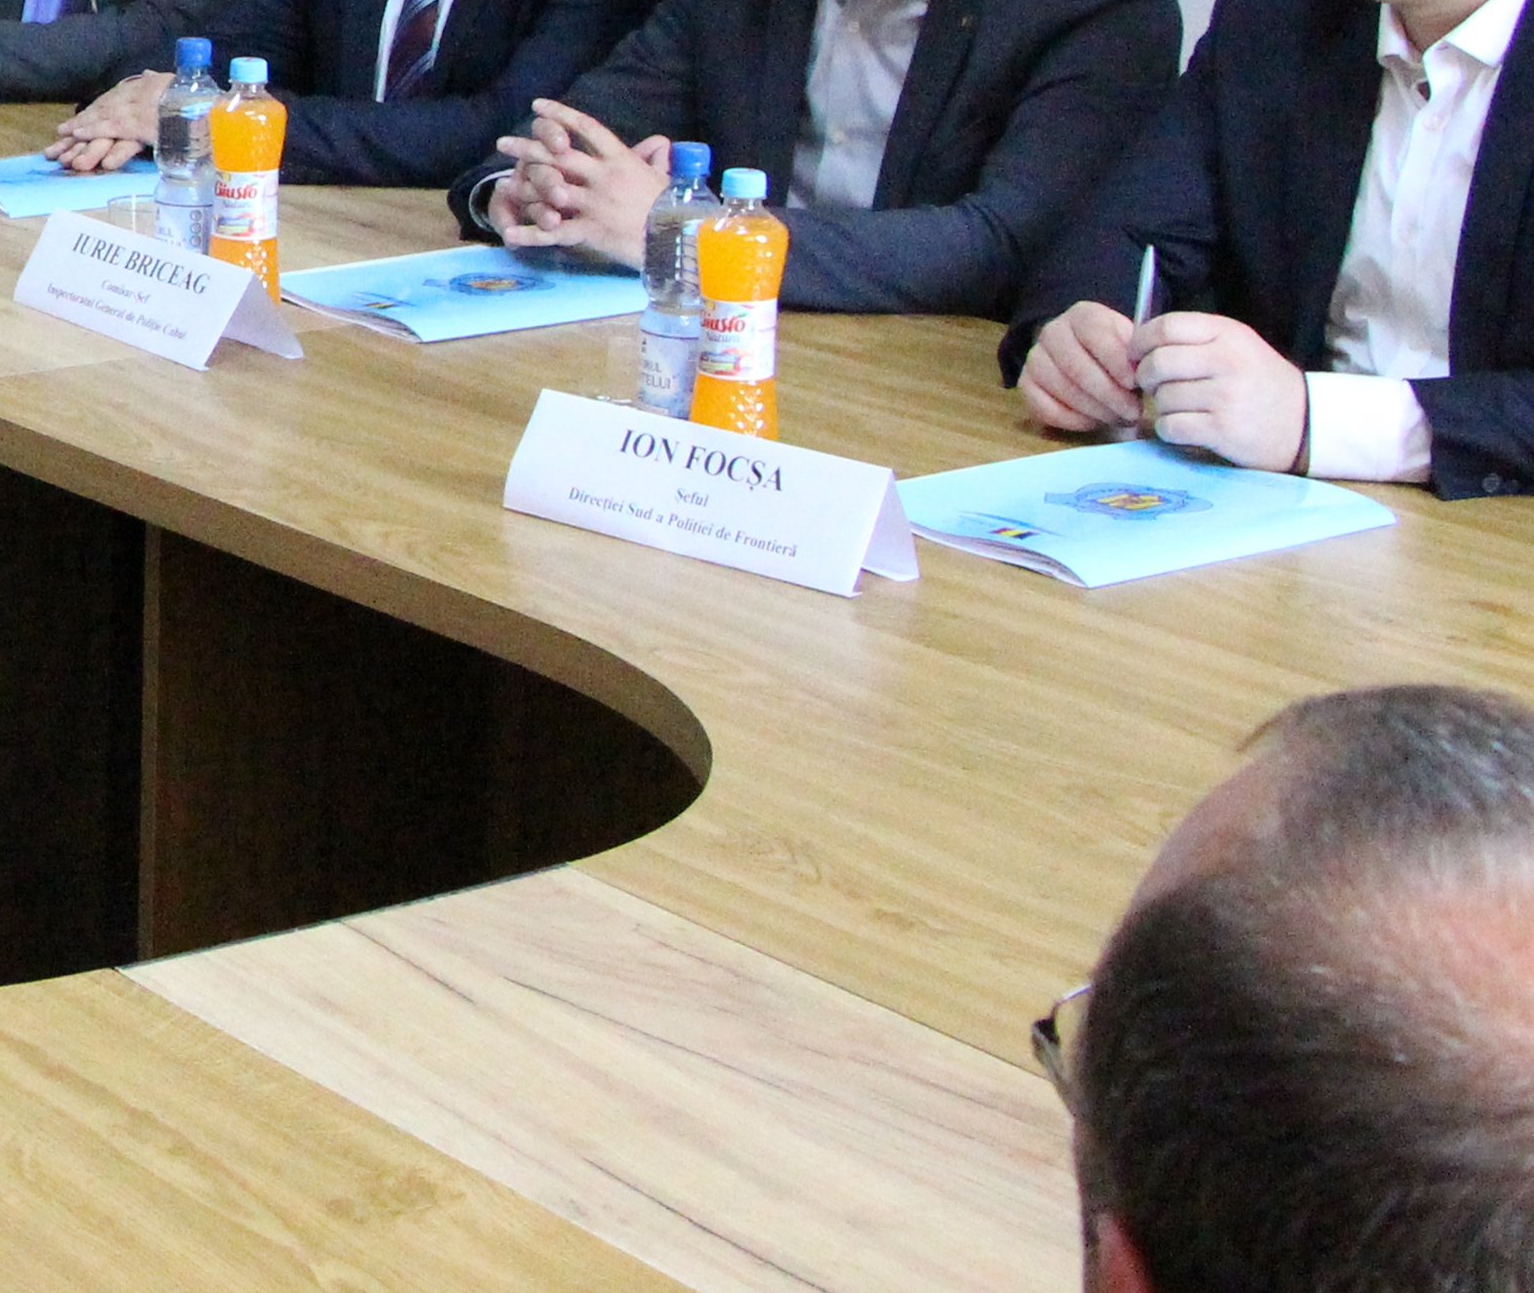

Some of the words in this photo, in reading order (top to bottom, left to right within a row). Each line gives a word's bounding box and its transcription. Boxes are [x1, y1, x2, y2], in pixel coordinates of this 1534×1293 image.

[71, 232, 126, 267] IURIE
[123, 250, 211, 295] BRICEAG
[94, 299, 125, 319] General
[125, 311, 136, 323] de
[618, 428, 680, 465] ION
[684, 444, 784, 492] FOCȘA
[568, 486, 624, 513] Direcției
[625, 501, 653, 521] Sud
[654, 513, 664, 524] a
[667, 512, 714, 537] Poliției
[714, 525, 732, 542] de
[733, 529, 798, 558] Frontieră
[674, 487, 709, 508] Șeful
